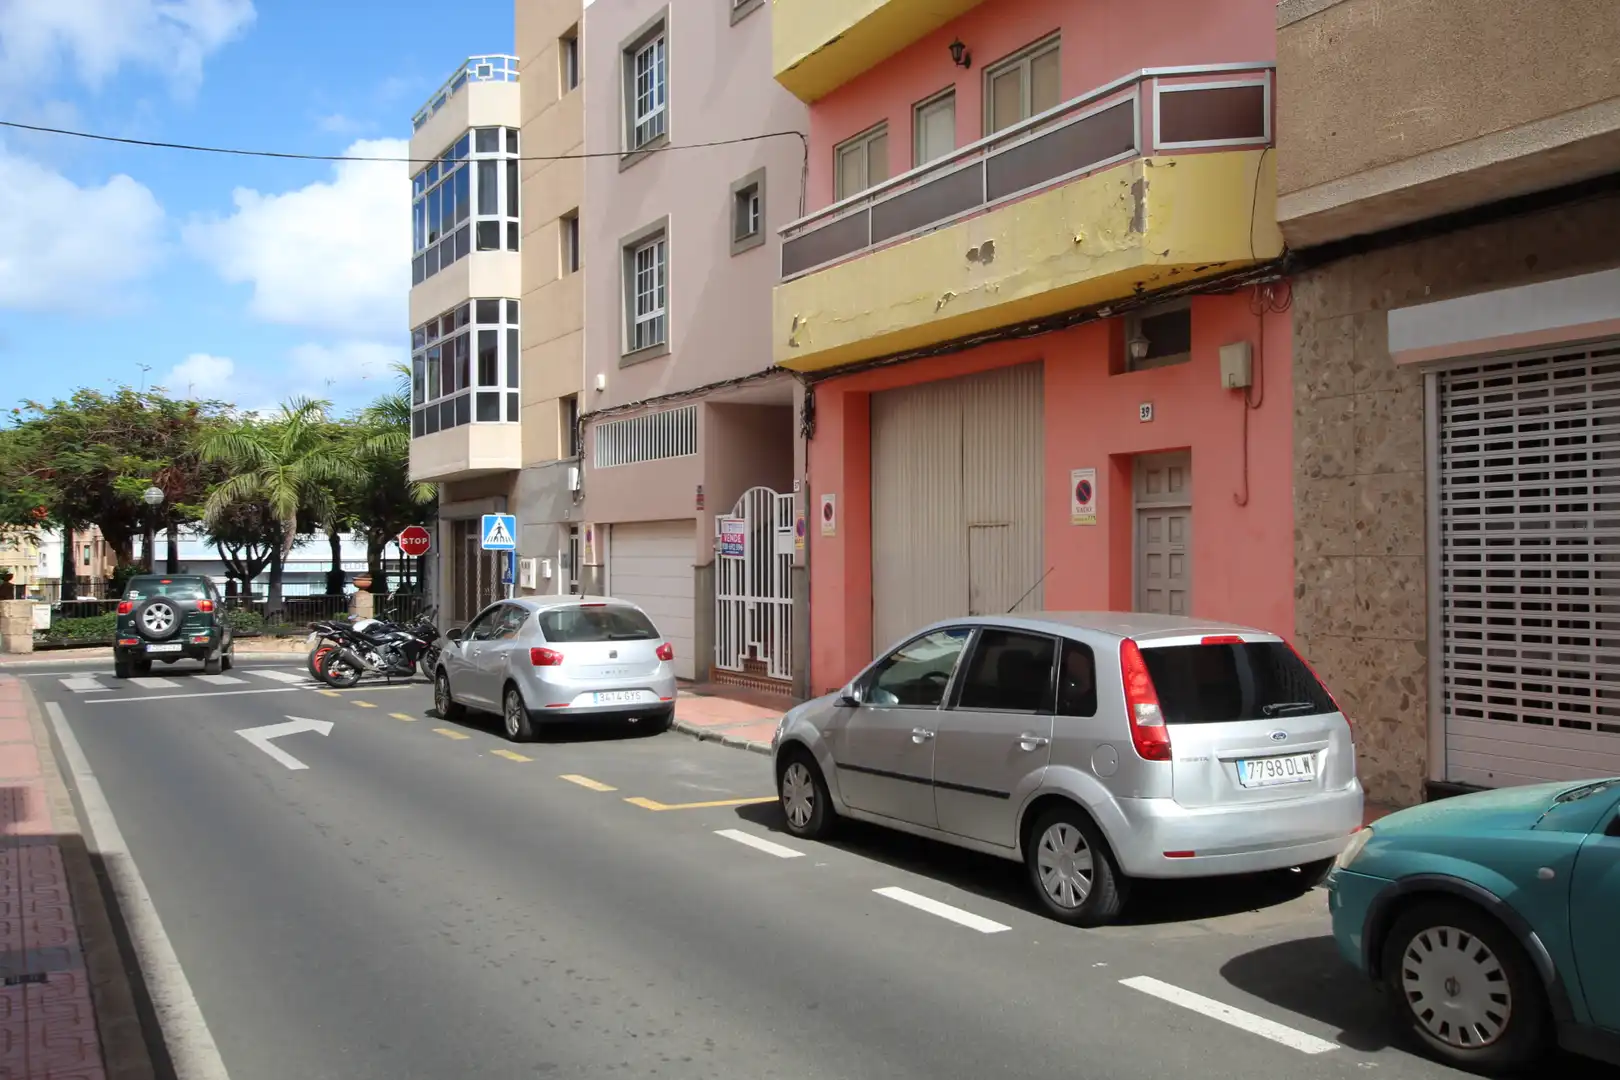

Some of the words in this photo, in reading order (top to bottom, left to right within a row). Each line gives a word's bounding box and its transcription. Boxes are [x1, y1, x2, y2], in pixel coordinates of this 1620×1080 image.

[402, 537, 428, 545] STOP
[723, 533, 742, 543] VENDE
[600, 692, 622, 702] 3414
[624, 691, 641, 701] GYS
[1247, 759, 1284, 779] 7798
[1285, 756, 1311, 776] DLW
